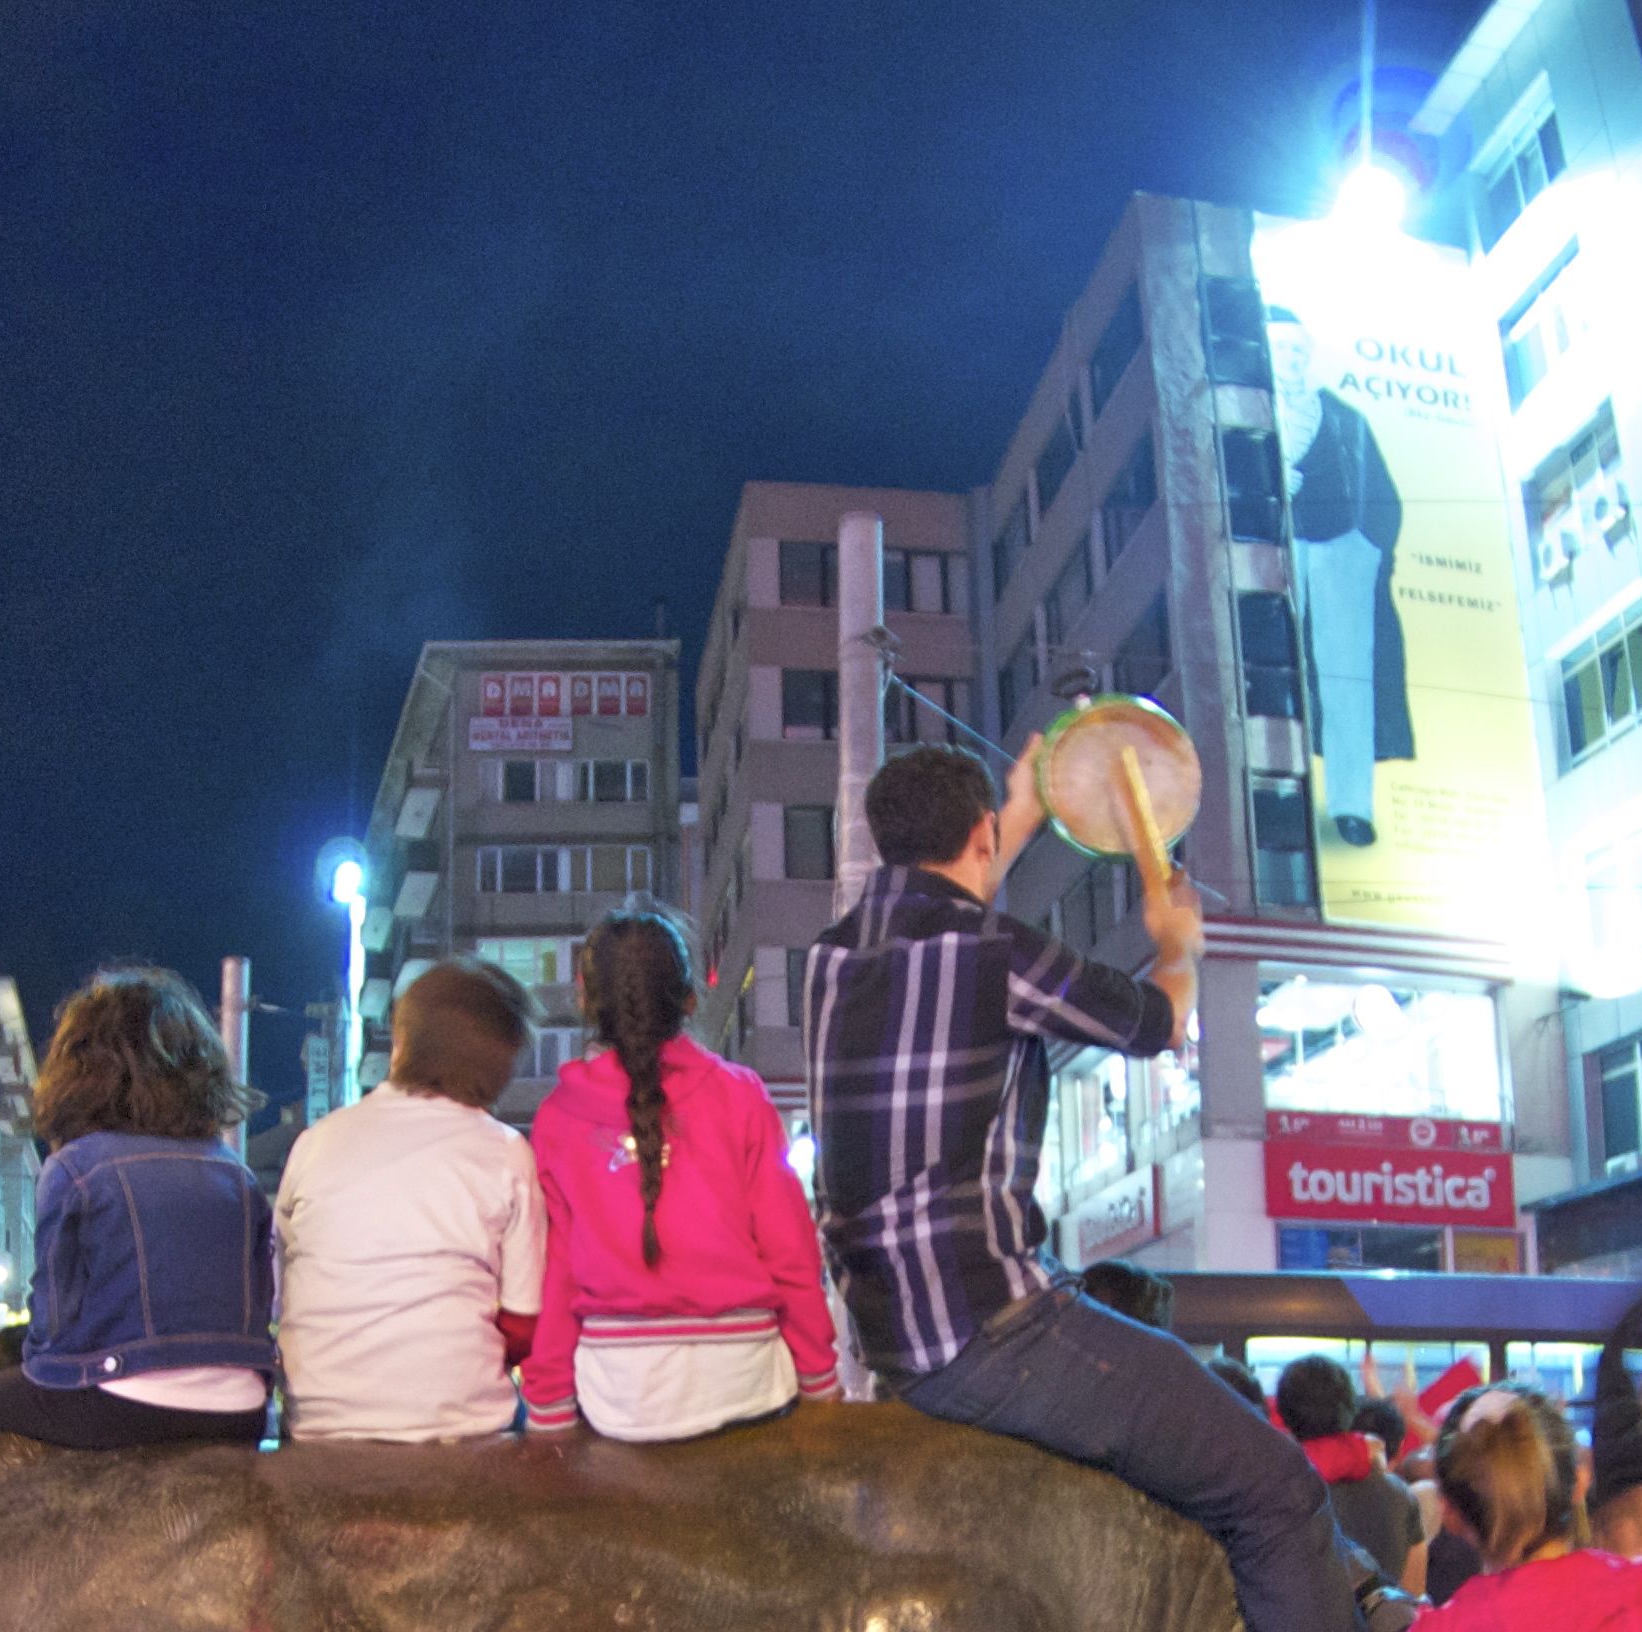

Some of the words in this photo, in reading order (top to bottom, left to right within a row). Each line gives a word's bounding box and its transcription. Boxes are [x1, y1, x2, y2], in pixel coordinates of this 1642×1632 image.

[1355, 337, 1466, 379] OKUL
[1339, 371, 1471, 413] AÇIYOR!
[1288, 1160, 1492, 1211] touristica
